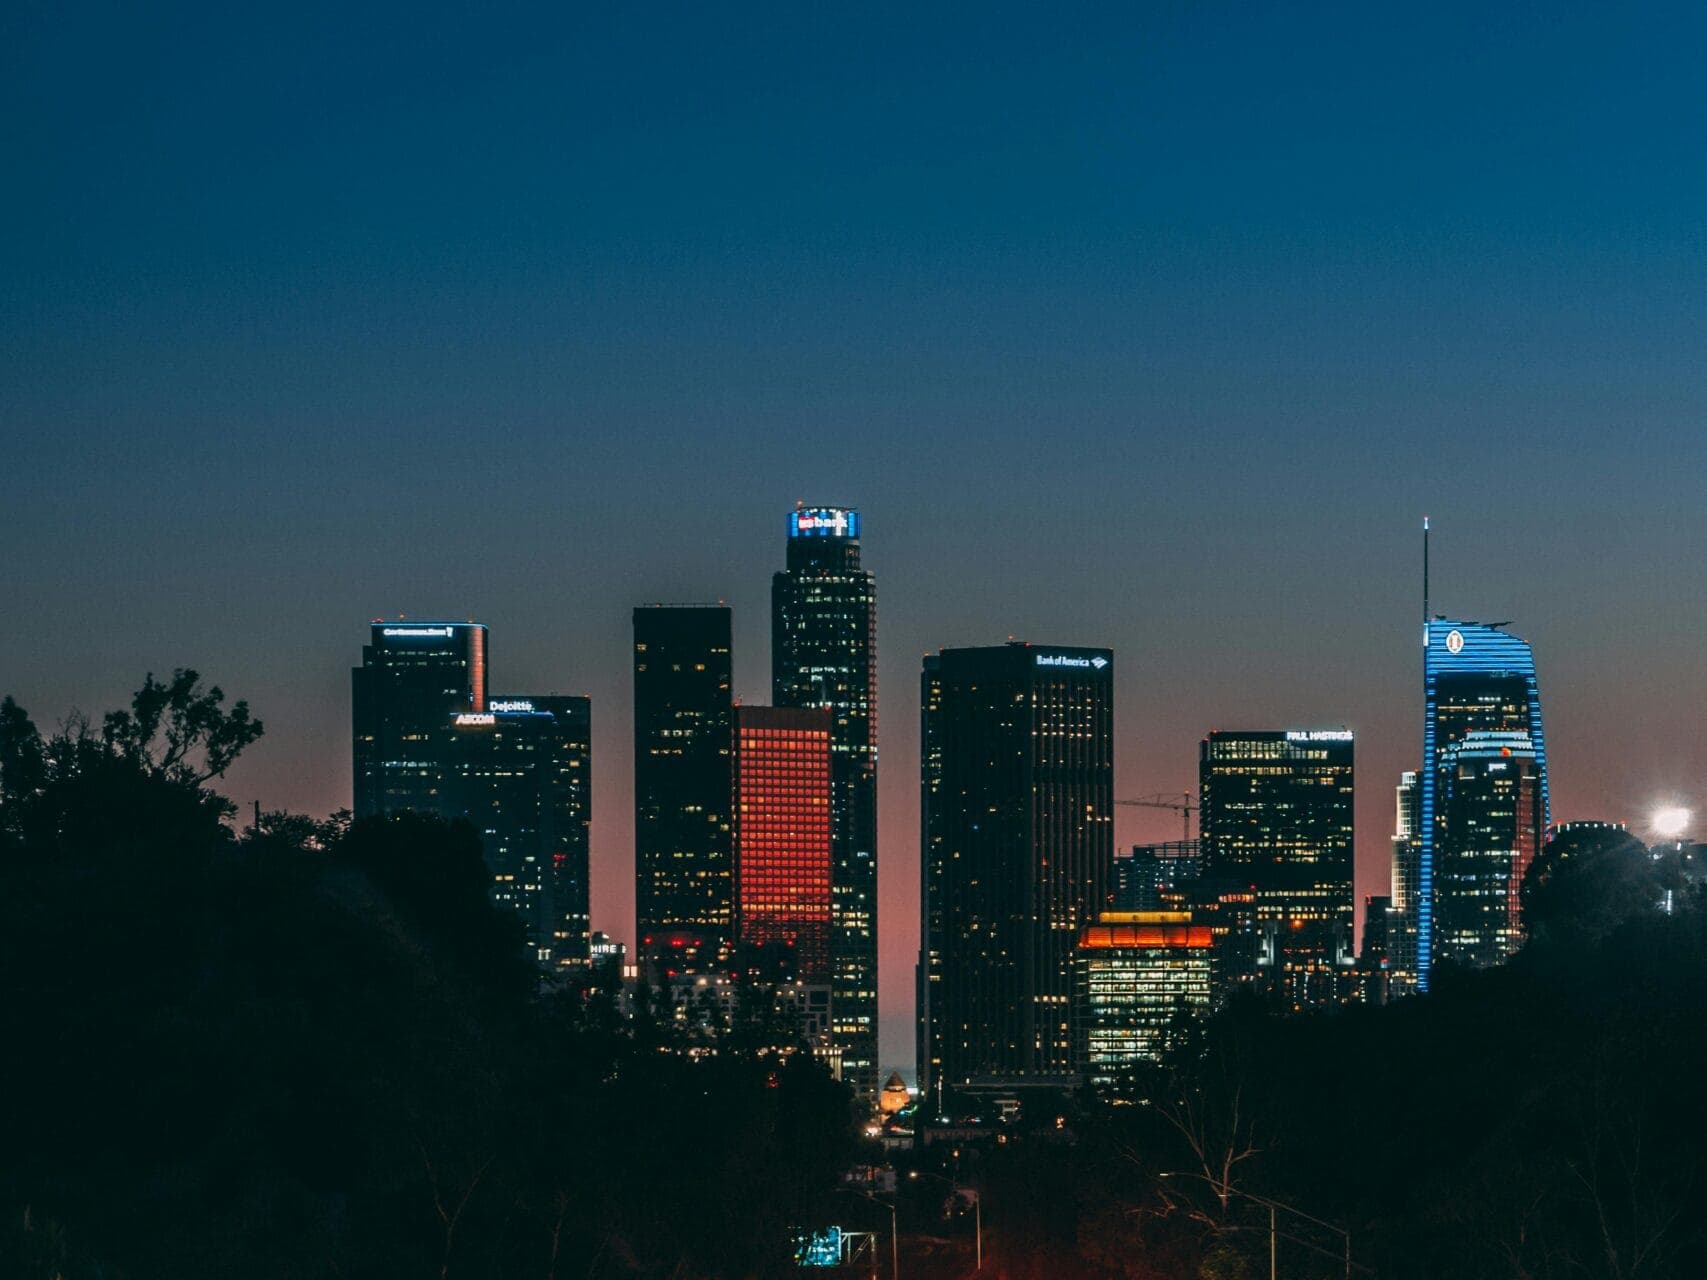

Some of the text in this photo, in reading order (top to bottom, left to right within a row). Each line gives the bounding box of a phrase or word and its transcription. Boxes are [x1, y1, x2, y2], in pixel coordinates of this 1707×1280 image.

[1037, 655, 1054, 665] Bank
[1062, 656, 1090, 667] America
[1287, 732, 1353, 741] PAUL HASTINGS
